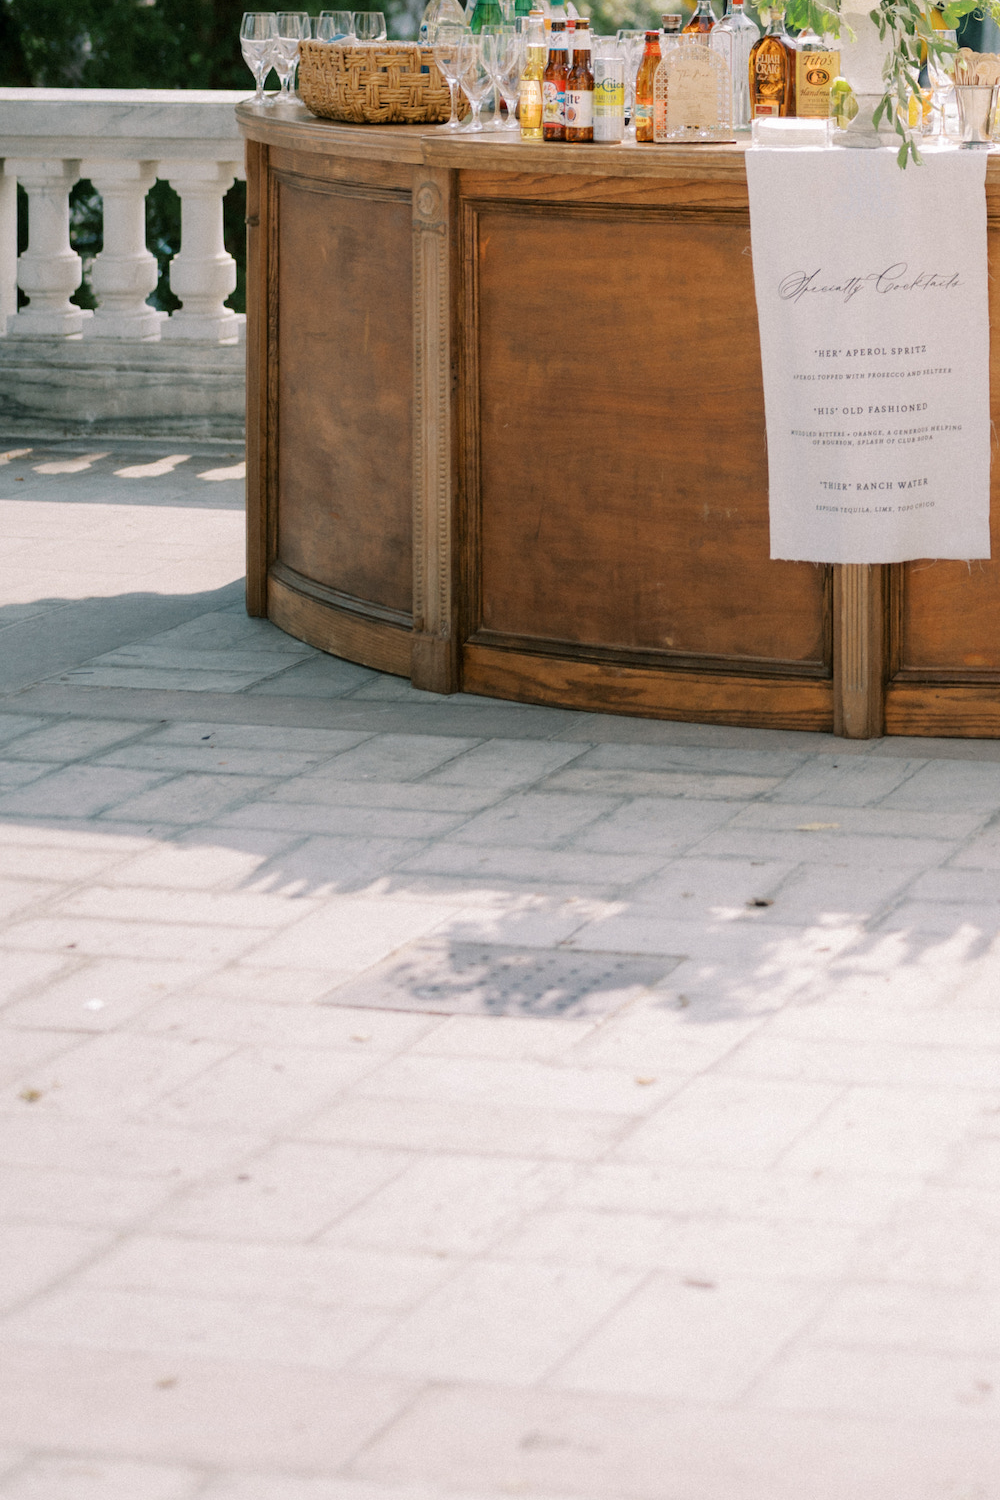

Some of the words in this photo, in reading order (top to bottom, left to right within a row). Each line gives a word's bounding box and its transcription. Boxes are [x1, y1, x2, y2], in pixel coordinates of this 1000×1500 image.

[757, 53, 780, 64] ELIJAH
[803, 54, 833, 66] Tito's
[756, 62, 780, 75] CRAIG
[778, 268, 865, 304] Specialty
[866, 262, 965, 294] Cocktails
[846, 347, 887, 357] APEROL
[891, 345, 926, 355] SPRITZ
[867, 371, 904, 379] PROSECCO
[907, 370, 921, 378] AND
[842, 407, 864, 415] OLD
[868, 402, 928, 414] FASHIONED
[930, 424, 962, 432] HELPING
[856, 481, 893, 491] RANCH
[897, 477, 929, 489] WATER
